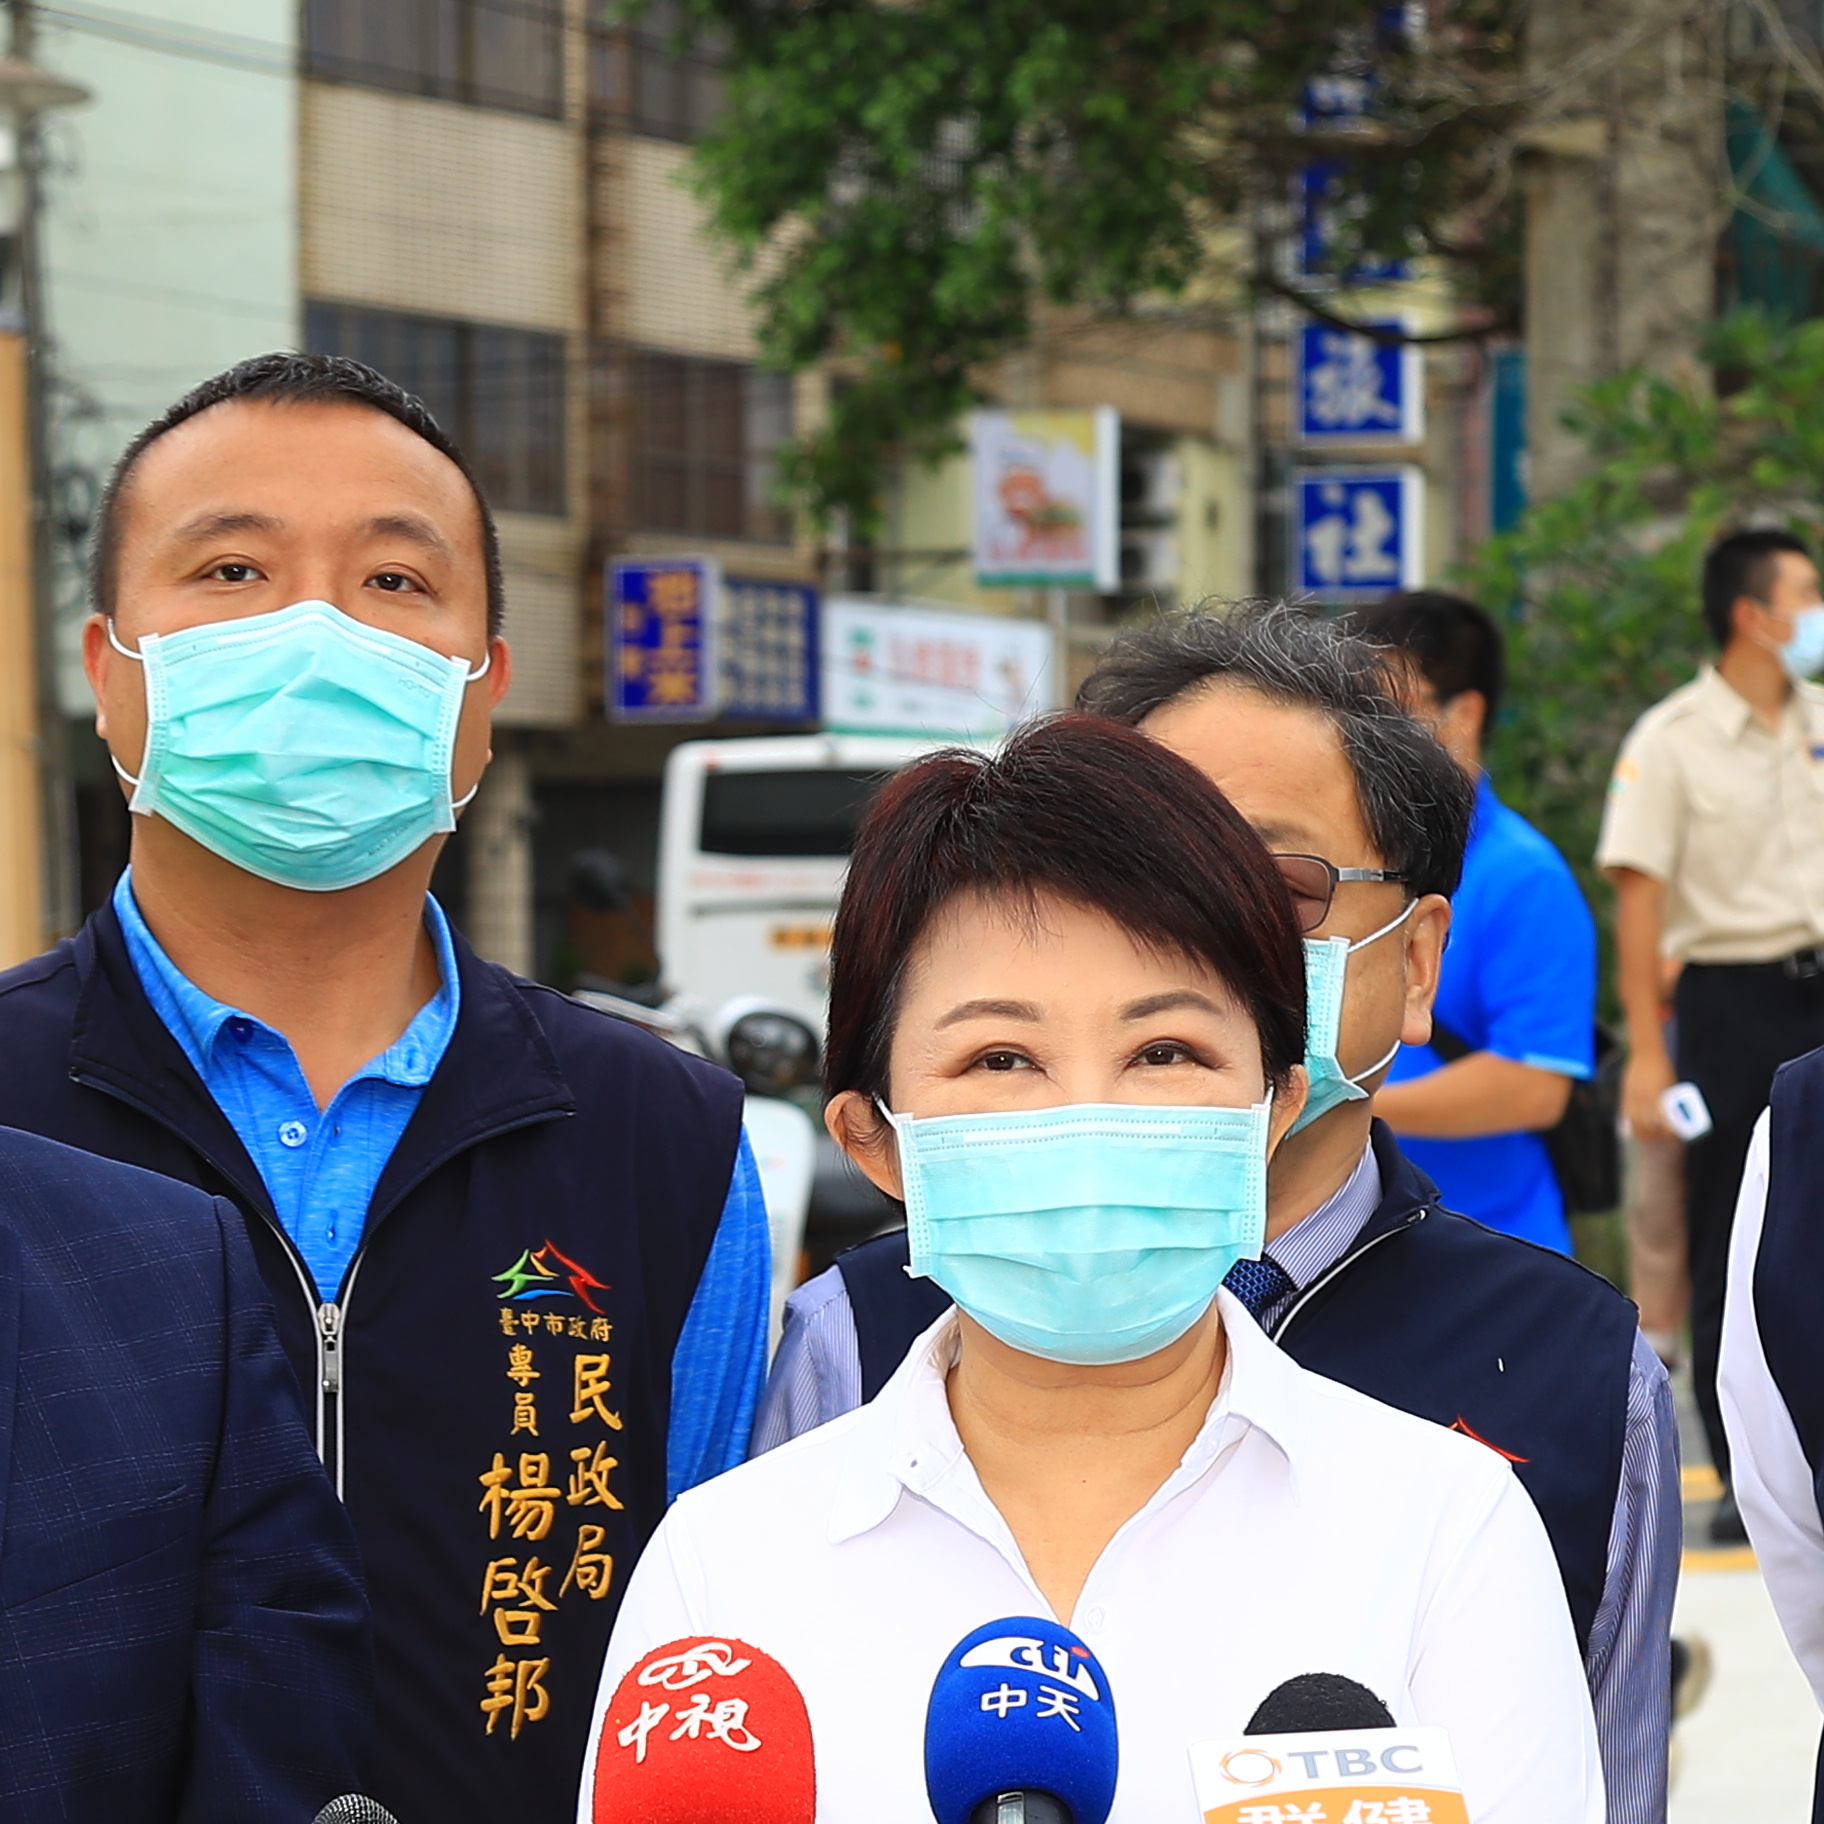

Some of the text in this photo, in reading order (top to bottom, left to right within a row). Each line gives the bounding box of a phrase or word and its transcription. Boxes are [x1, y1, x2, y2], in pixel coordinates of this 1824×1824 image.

[498, 1307, 613, 1342] 臺中市政府
[506, 1343, 542, 1437] 專員
[559, 1353, 625, 1600] 民政局
[616, 1693, 762, 1764] 中視
[980, 1683, 1082, 1732] 中天
[1287, 1744, 1424, 1780] TBC
